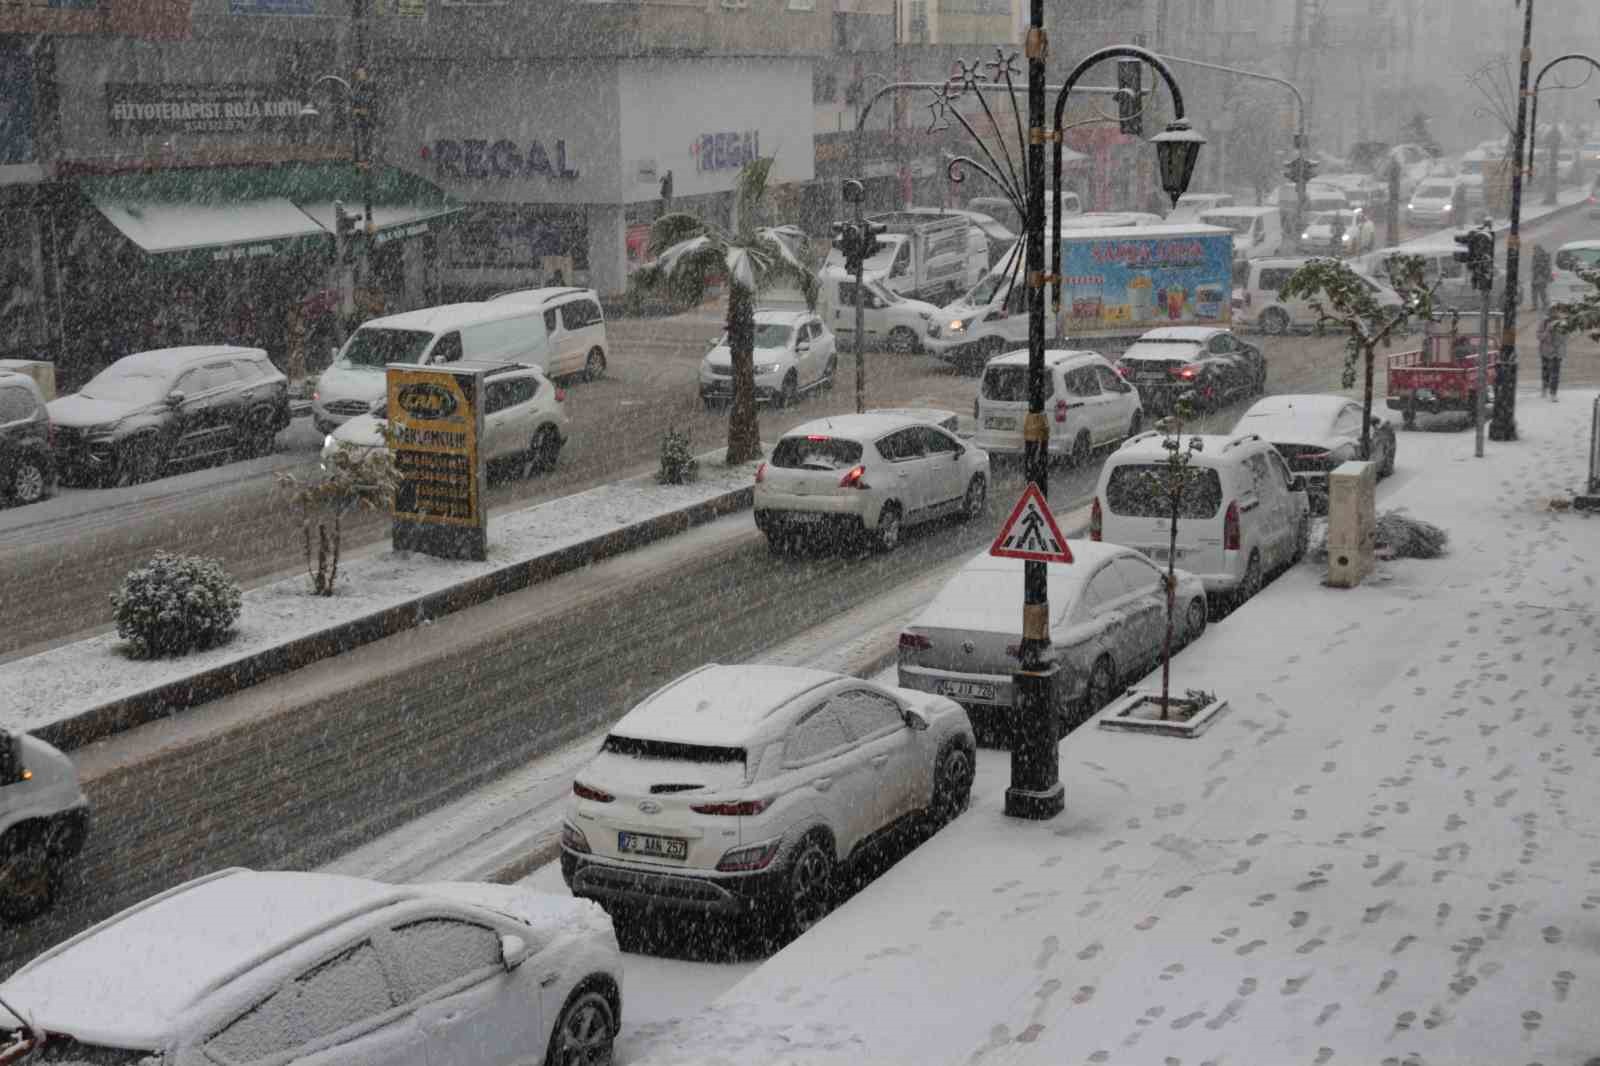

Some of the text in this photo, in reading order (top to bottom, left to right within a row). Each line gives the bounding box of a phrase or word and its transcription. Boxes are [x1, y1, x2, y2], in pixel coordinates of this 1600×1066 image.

[434, 138, 579, 179] REGAL
[624, 836, 637, 848] 73
[667, 840, 685, 855] 257
